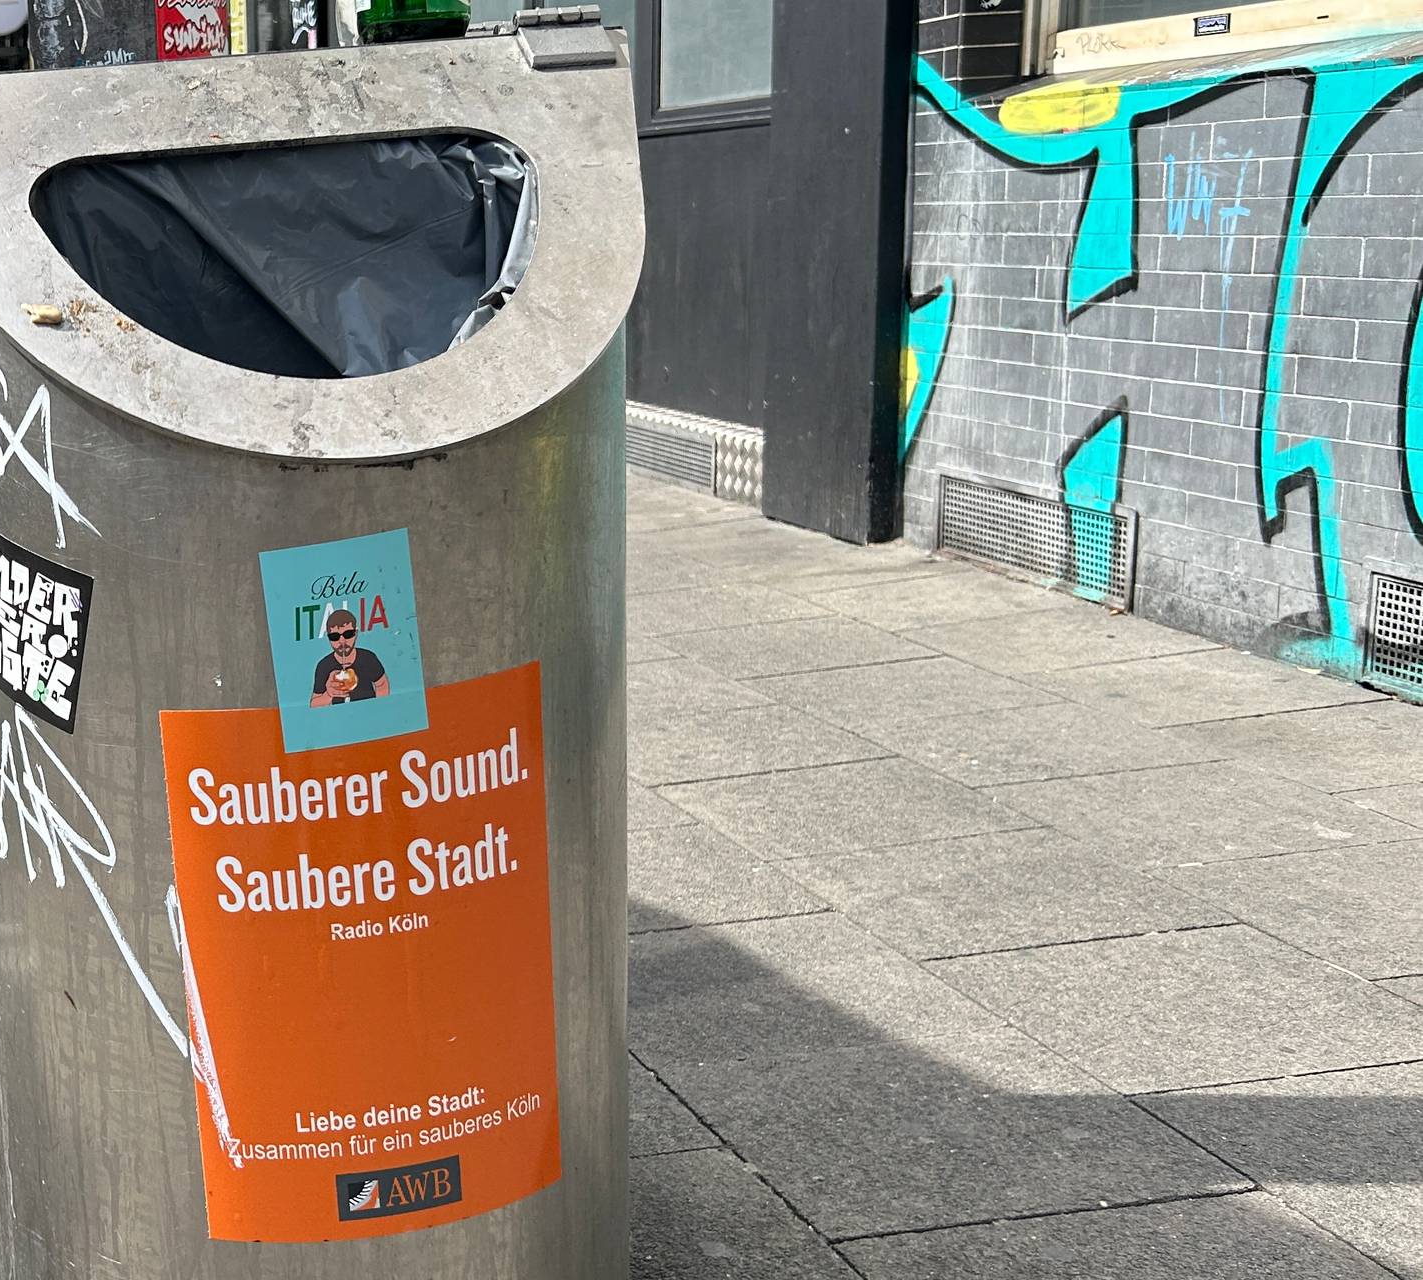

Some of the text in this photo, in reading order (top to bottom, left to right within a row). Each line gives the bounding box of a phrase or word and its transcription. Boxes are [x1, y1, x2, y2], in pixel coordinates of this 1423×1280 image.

[311, 571, 369, 600] Béla
[294, 594, 389, 642] ITAIA
[188, 727, 529, 825] Sauberer Sound.
[215, 822, 519, 913] Saubere Stadt.
[330, 913, 429, 941] Radio Köln
[228, 1091, 541, 1161] Zusammen für ein sauberes Köln
[295, 1087, 486, 1134] Liebe deine Stadt:
[385, 1167, 453, 1208] AWB
